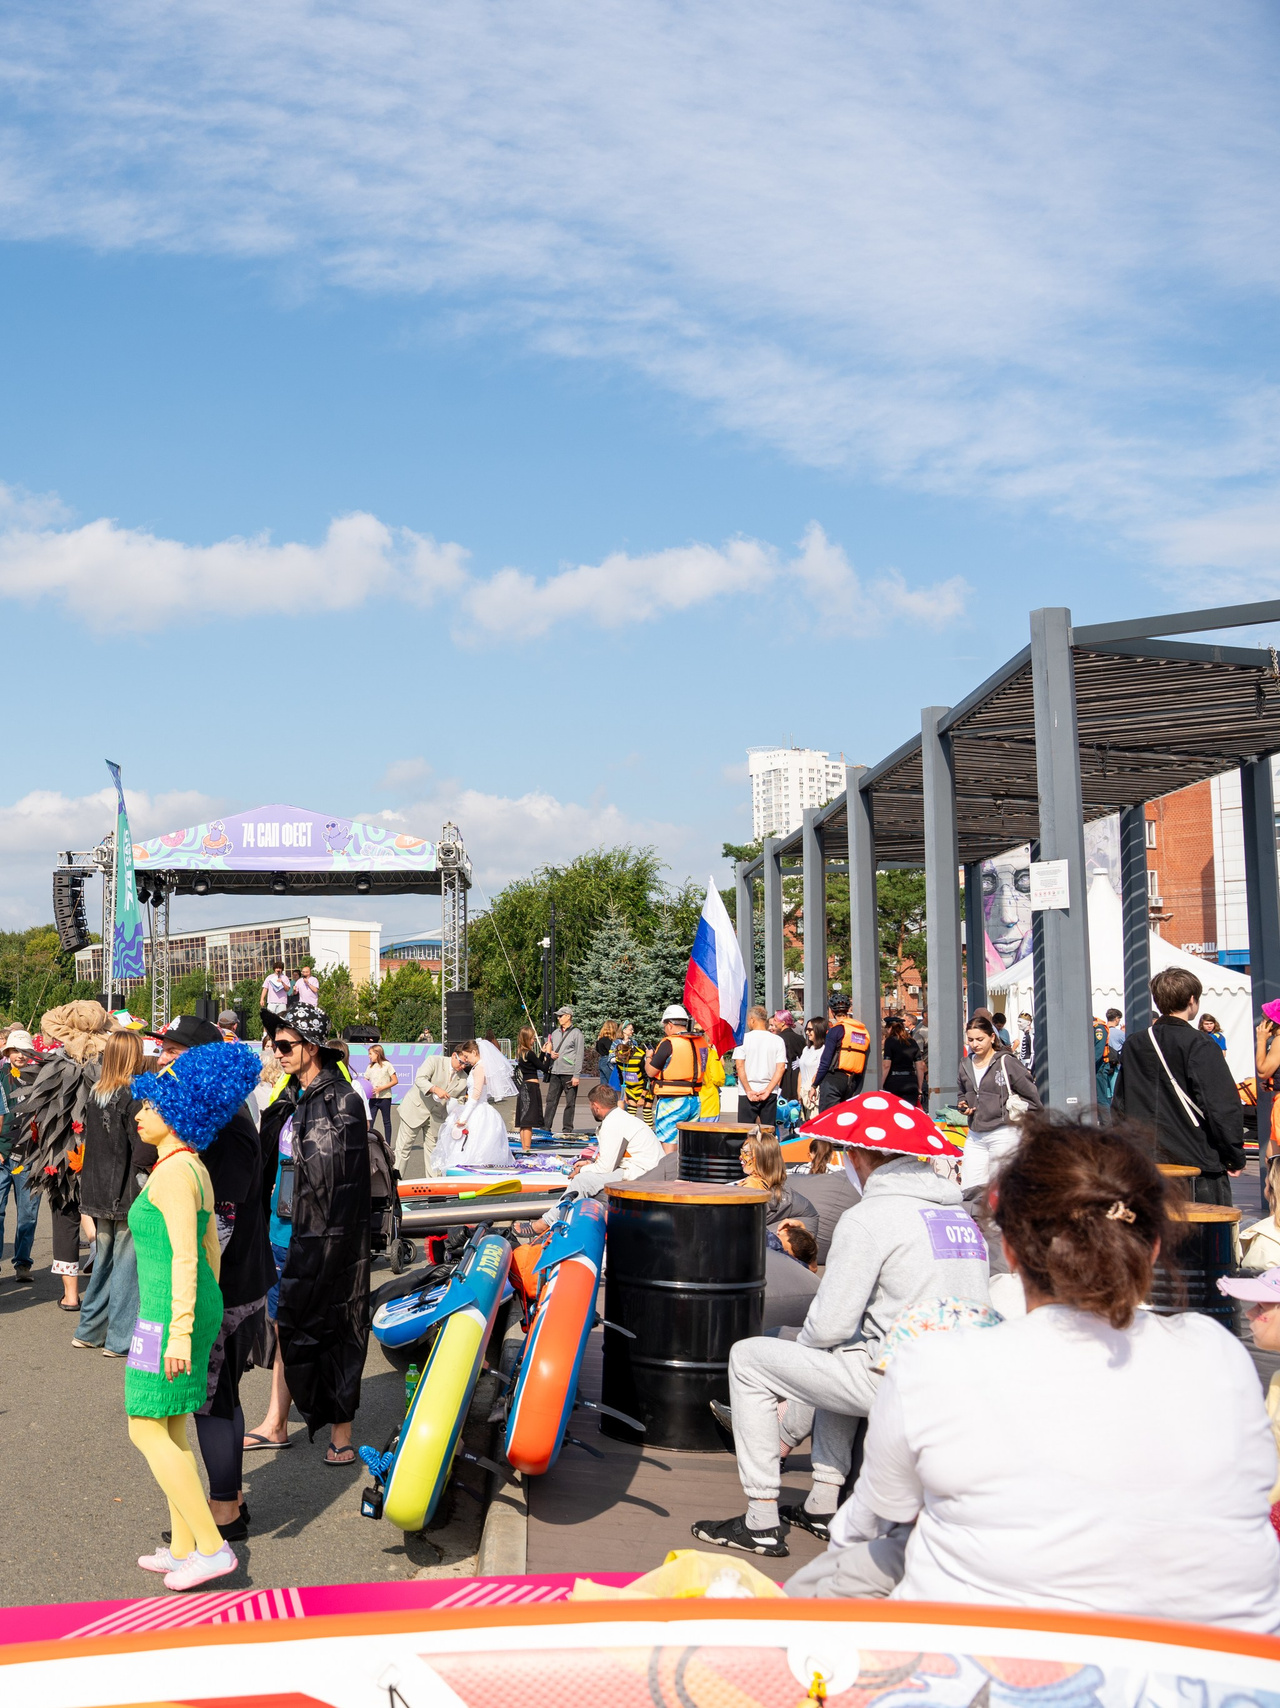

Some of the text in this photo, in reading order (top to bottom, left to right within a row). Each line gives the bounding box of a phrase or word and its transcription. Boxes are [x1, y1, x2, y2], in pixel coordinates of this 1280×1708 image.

[242, 822, 313, 848] 74 САП ФЕСТ
[945, 1225, 978, 1243] 0732
